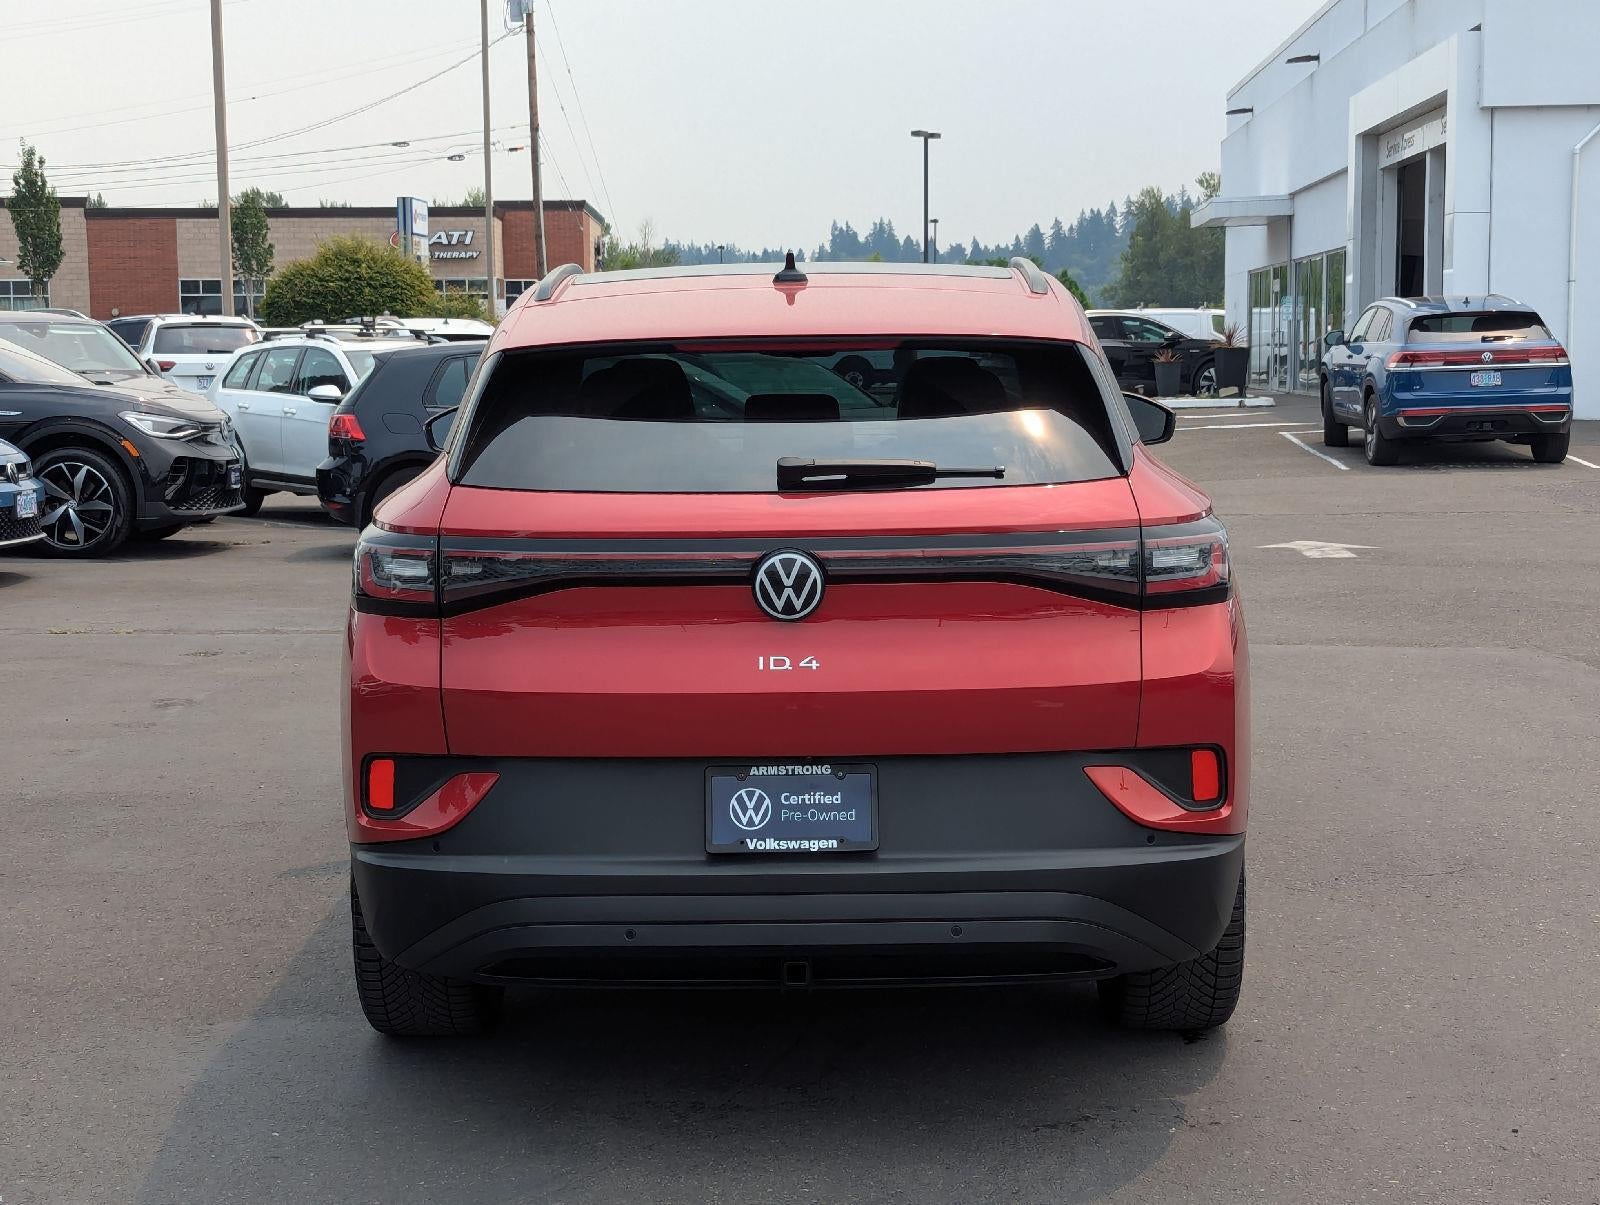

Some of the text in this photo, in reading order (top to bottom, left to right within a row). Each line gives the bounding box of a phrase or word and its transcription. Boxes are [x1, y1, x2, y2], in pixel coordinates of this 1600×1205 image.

[428, 231, 475, 245] ATI
[434, 252, 480, 260] THERAPY
[750, 765, 831, 776] ARMSTRONG
[781, 792, 841, 804] Certified
[781, 809, 855, 821] Pre-Owned
[746, 838, 838, 851] Volkswagen
